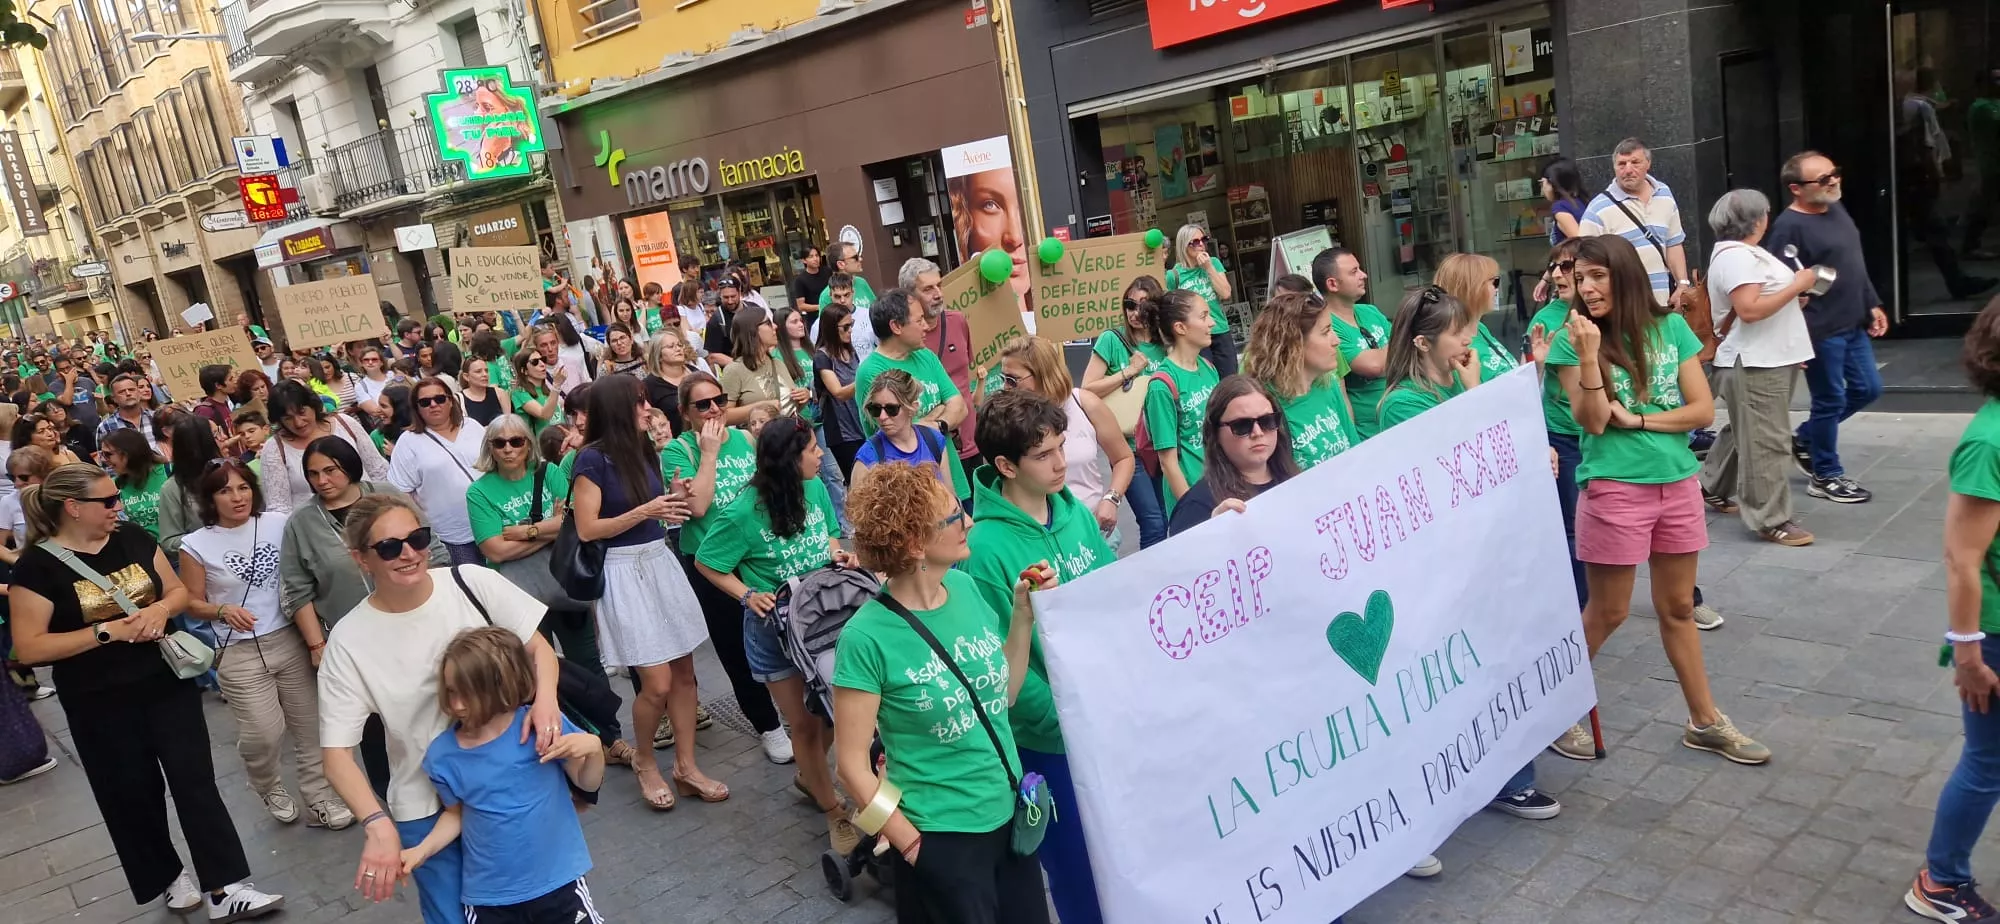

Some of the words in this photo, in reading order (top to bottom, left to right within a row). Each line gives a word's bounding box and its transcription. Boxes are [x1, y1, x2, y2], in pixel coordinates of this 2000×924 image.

[625, 157, 709, 207] marro
[718, 145, 805, 187] farmacia
[253, 209, 284, 220] 18:20
[474, 218, 518, 236] CUARZOS
[294, 235, 322, 252] TABACOS
[635, 243, 652, 254] ULTRA
[455, 255, 472, 268] LA
[476, 251, 532, 268] EDUCACIÓN
[1069, 249, 1126, 275] VERDE
[1135, 250, 1156, 266] SE
[457, 273, 479, 289] NO
[1041, 277, 1120, 300] DEFIENDE
[465, 294, 481, 304] SE
[491, 288, 540, 304] DEFIENDE
[304, 305, 330, 316] PARA
[335, 302, 351, 312] LA
[1041, 297, 1120, 319] GOBIERNE
[298, 312, 374, 340] PÚBLICA
[169, 363, 188, 379] LA
[1314, 466, 1434, 580] JUAN
[1436, 420, 1519, 508] XXIII
[1207, 776, 1261, 840] LA
[1264, 693, 1392, 798] ESCUELA
[1396, 629, 1481, 725] PÚBLICA
[1246, 866, 1284, 922] ES
[1292, 788, 1413, 890] NUESTRA,
[1421, 711, 1491, 806] PORQUE
[1488, 692, 1509, 741] ES
[1507, 671, 1533, 721] DE
[1534, 630, 1582, 697] TODOS
